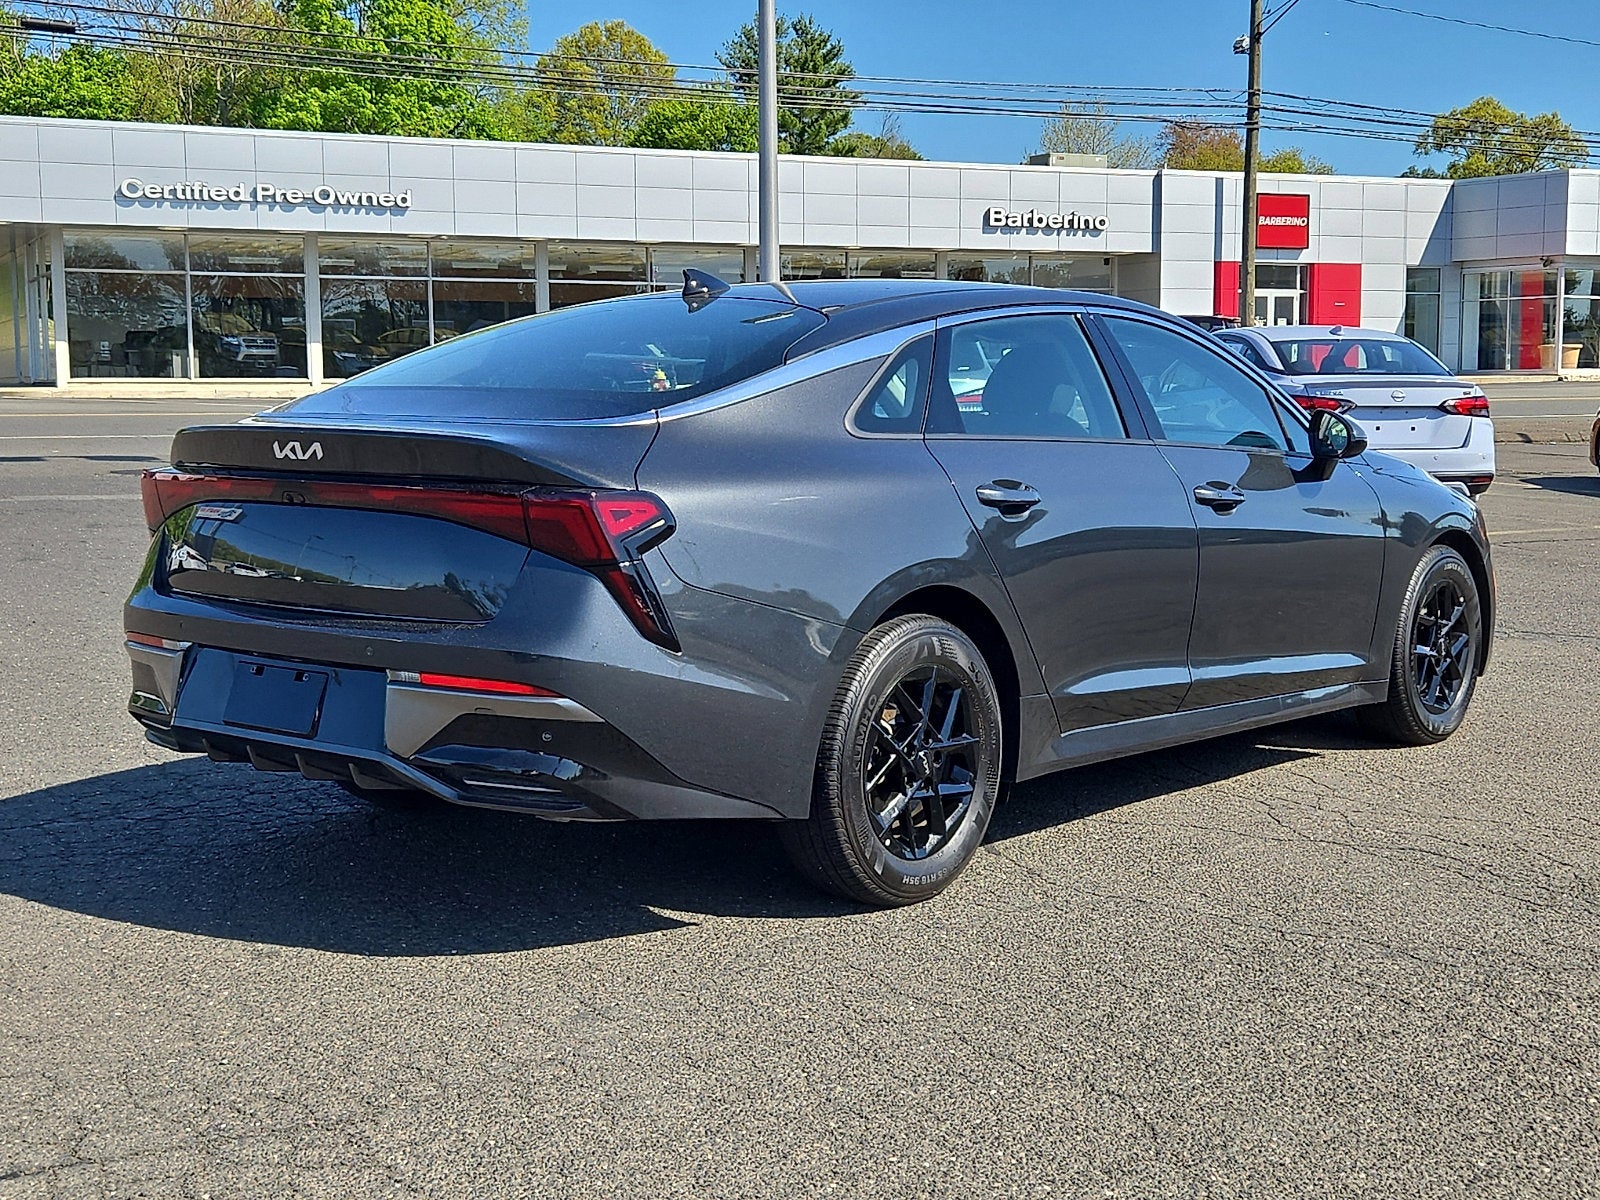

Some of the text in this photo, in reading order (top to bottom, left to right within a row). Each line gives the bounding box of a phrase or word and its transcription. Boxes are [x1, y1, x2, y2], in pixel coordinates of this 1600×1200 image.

[120, 178, 413, 208] Certified Pre-Owned
[988, 206, 1110, 231] Barberino
[1258, 215, 1308, 227] BARBERINO
[272, 440, 324, 461] KIA
[902, 874, 921, 886] 95H
